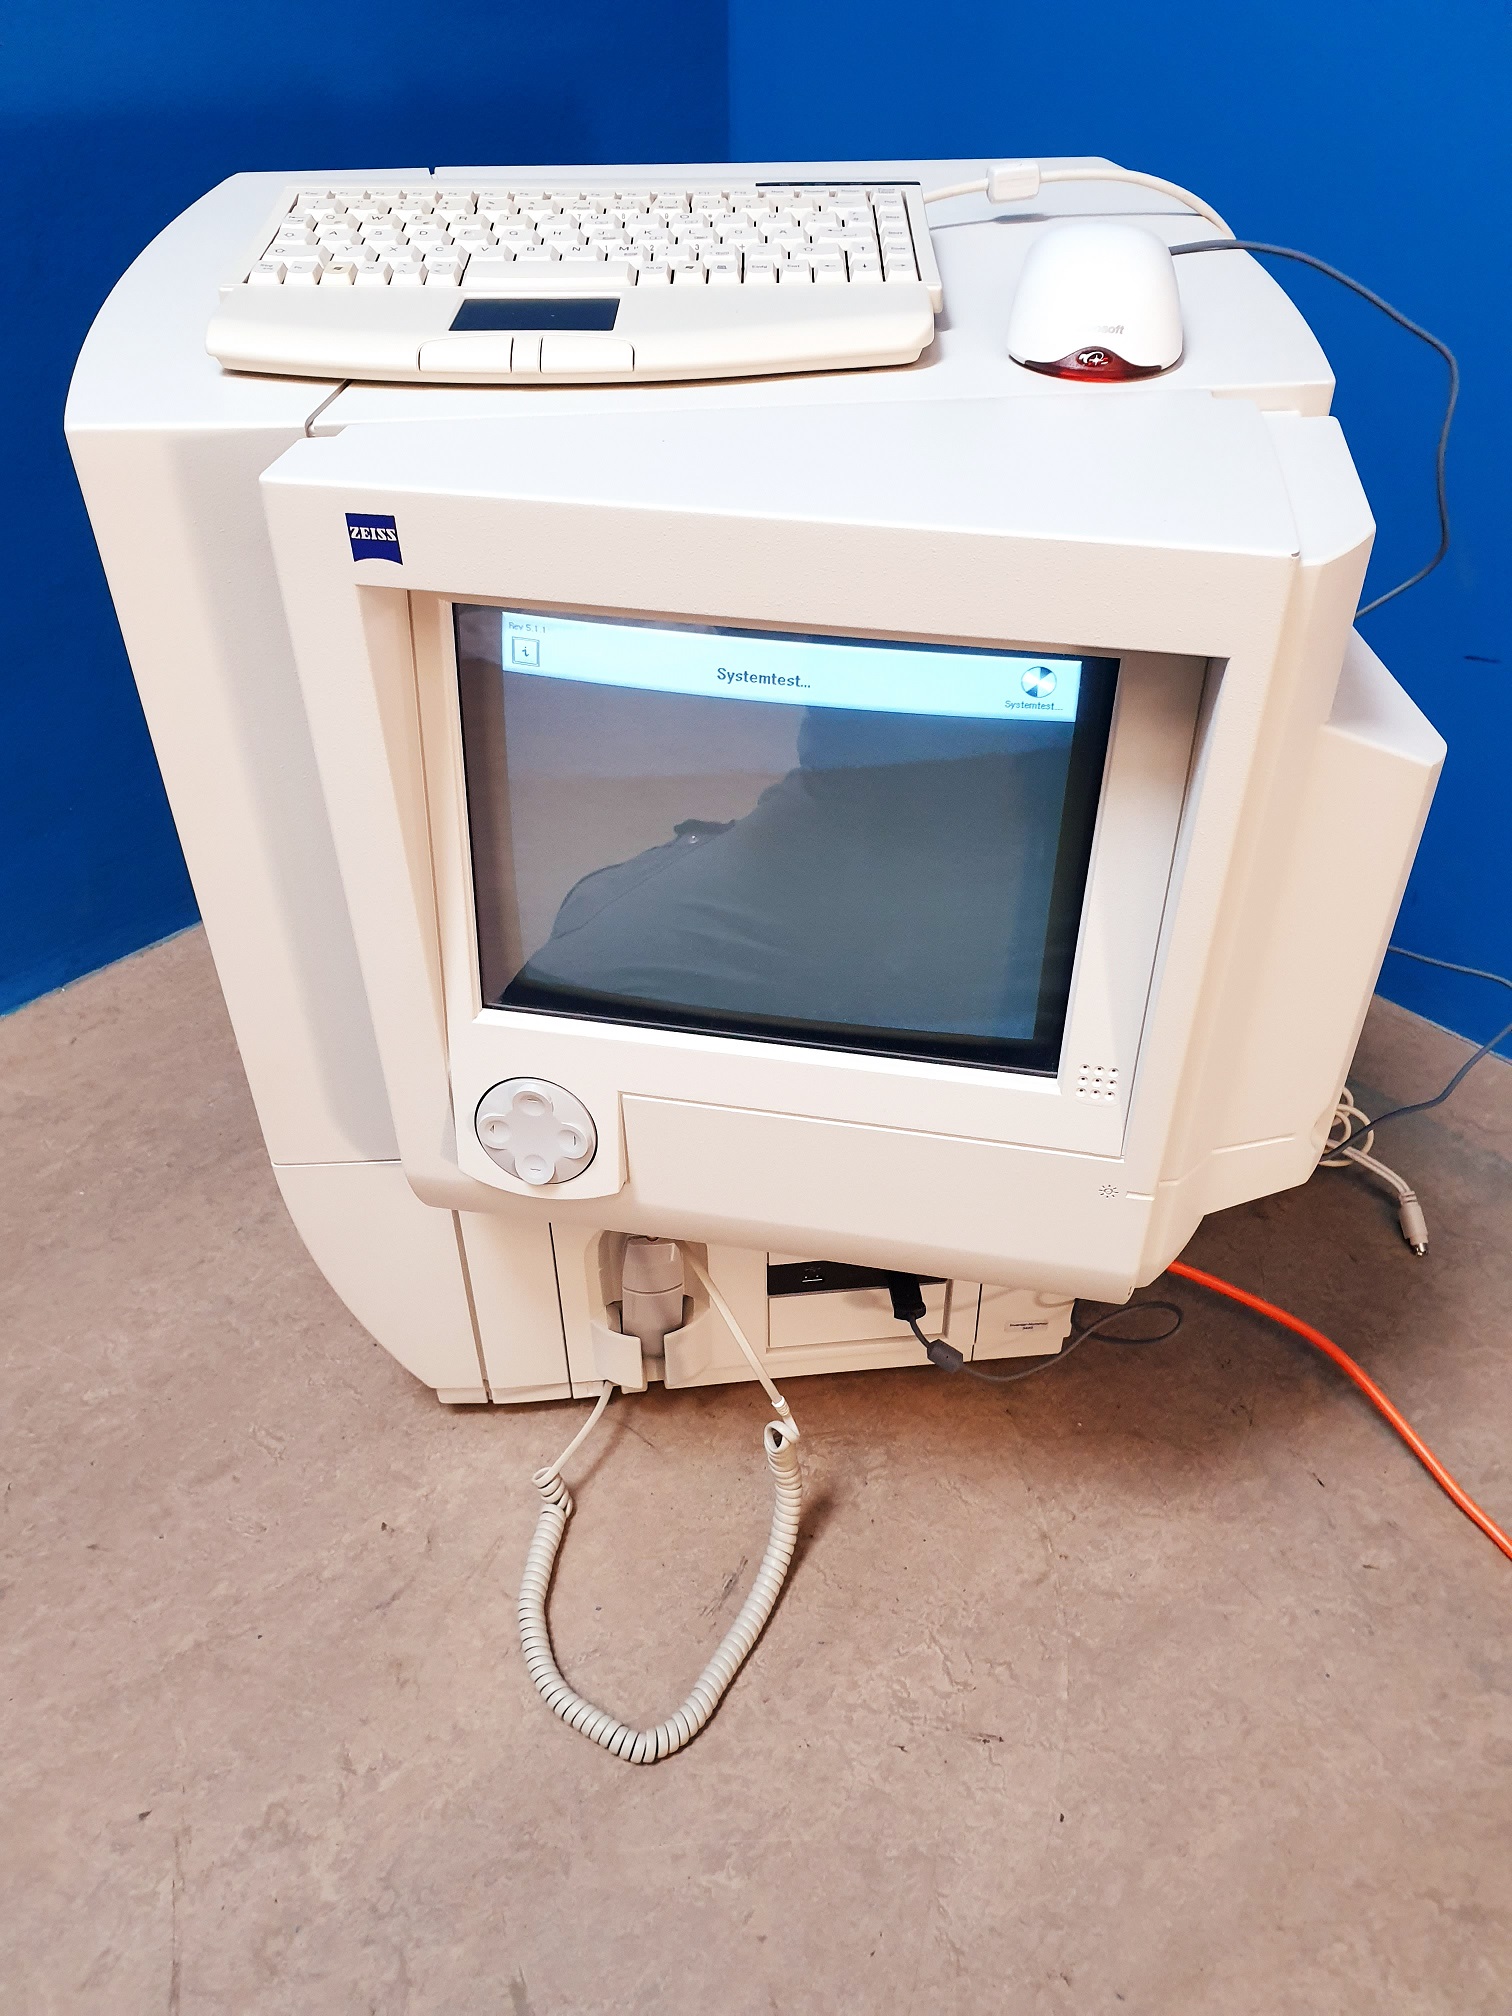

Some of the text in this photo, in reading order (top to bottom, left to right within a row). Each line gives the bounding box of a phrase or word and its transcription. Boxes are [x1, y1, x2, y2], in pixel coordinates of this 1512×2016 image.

[349, 526, 397, 541] ZEISS
[508, 621, 524, 631] Rev
[717, 667, 811, 688] Systemtest...
